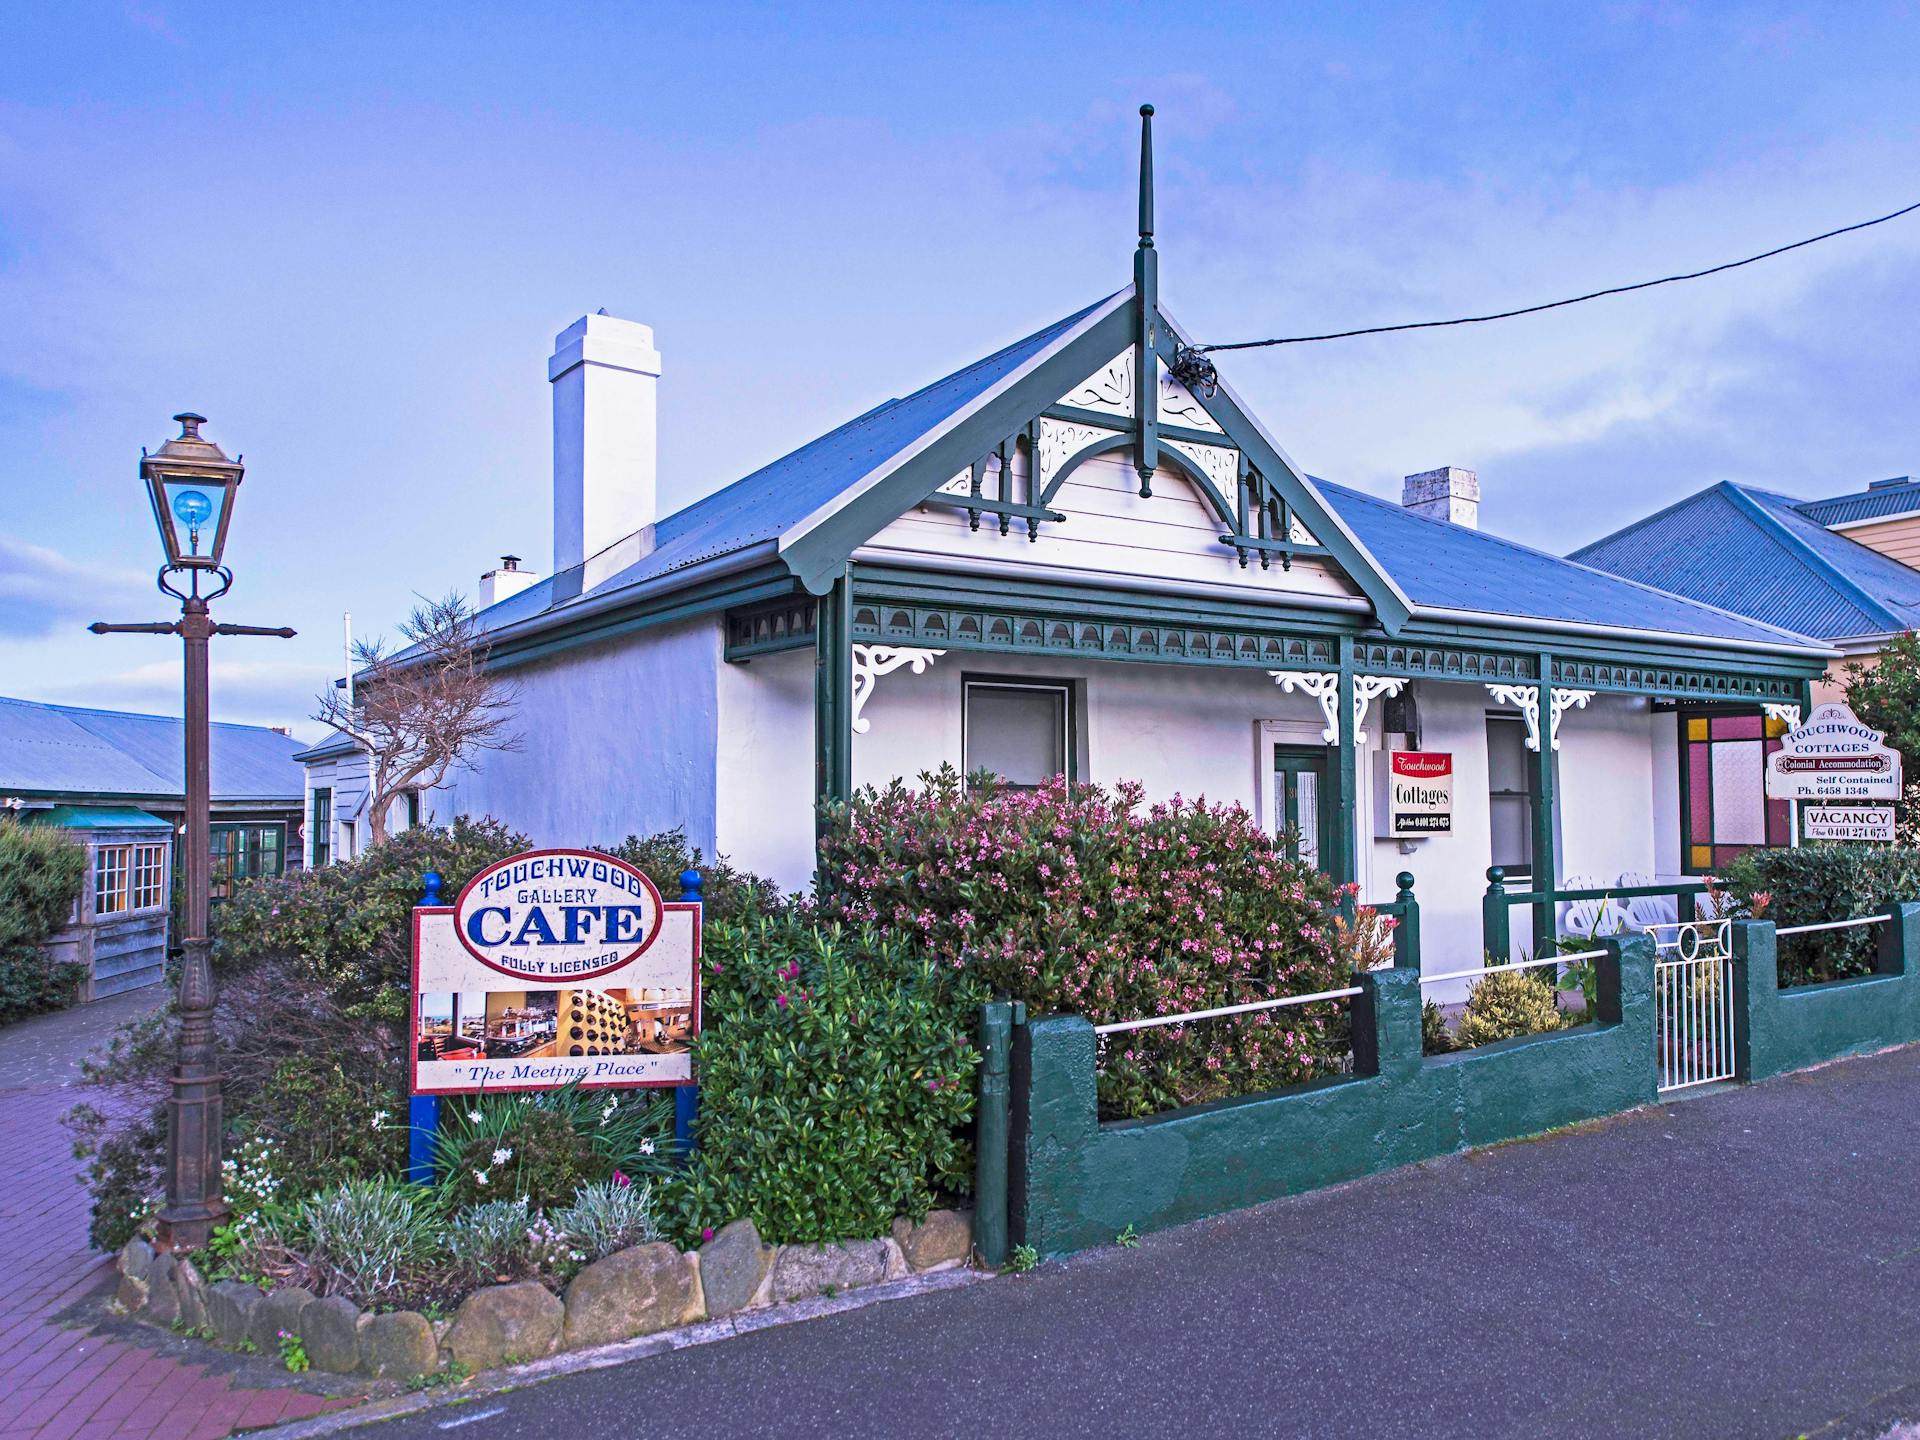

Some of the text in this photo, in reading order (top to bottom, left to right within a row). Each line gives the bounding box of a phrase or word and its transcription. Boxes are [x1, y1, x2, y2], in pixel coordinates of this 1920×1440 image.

[1788, 725, 1879, 743] TOUCHWOOD
[1795, 744, 1869, 753] COTTAGES
[1398, 756, 1446, 771] Touchwood
[1784, 759, 1882, 769] Colonial Accommodation
[1816, 775, 1893, 784] Self Contained
[1396, 783, 1449, 810] Cottages
[1798, 786, 1869, 795] Ph. 6458 1348
[1809, 812, 1889, 824] VACANCY
[1827, 827, 1850, 837] 0401
[480, 858, 641, 898] TOUCHWOOD
[518, 888, 598, 904] GALLERY
[467, 905, 643, 947] CAFE
[501, 951, 619, 973] FULLY LICENSED
[469, 1066, 505, 1081] The
[511, 1063, 589, 1080] Meeting
[593, 1062, 645, 1076] Place
